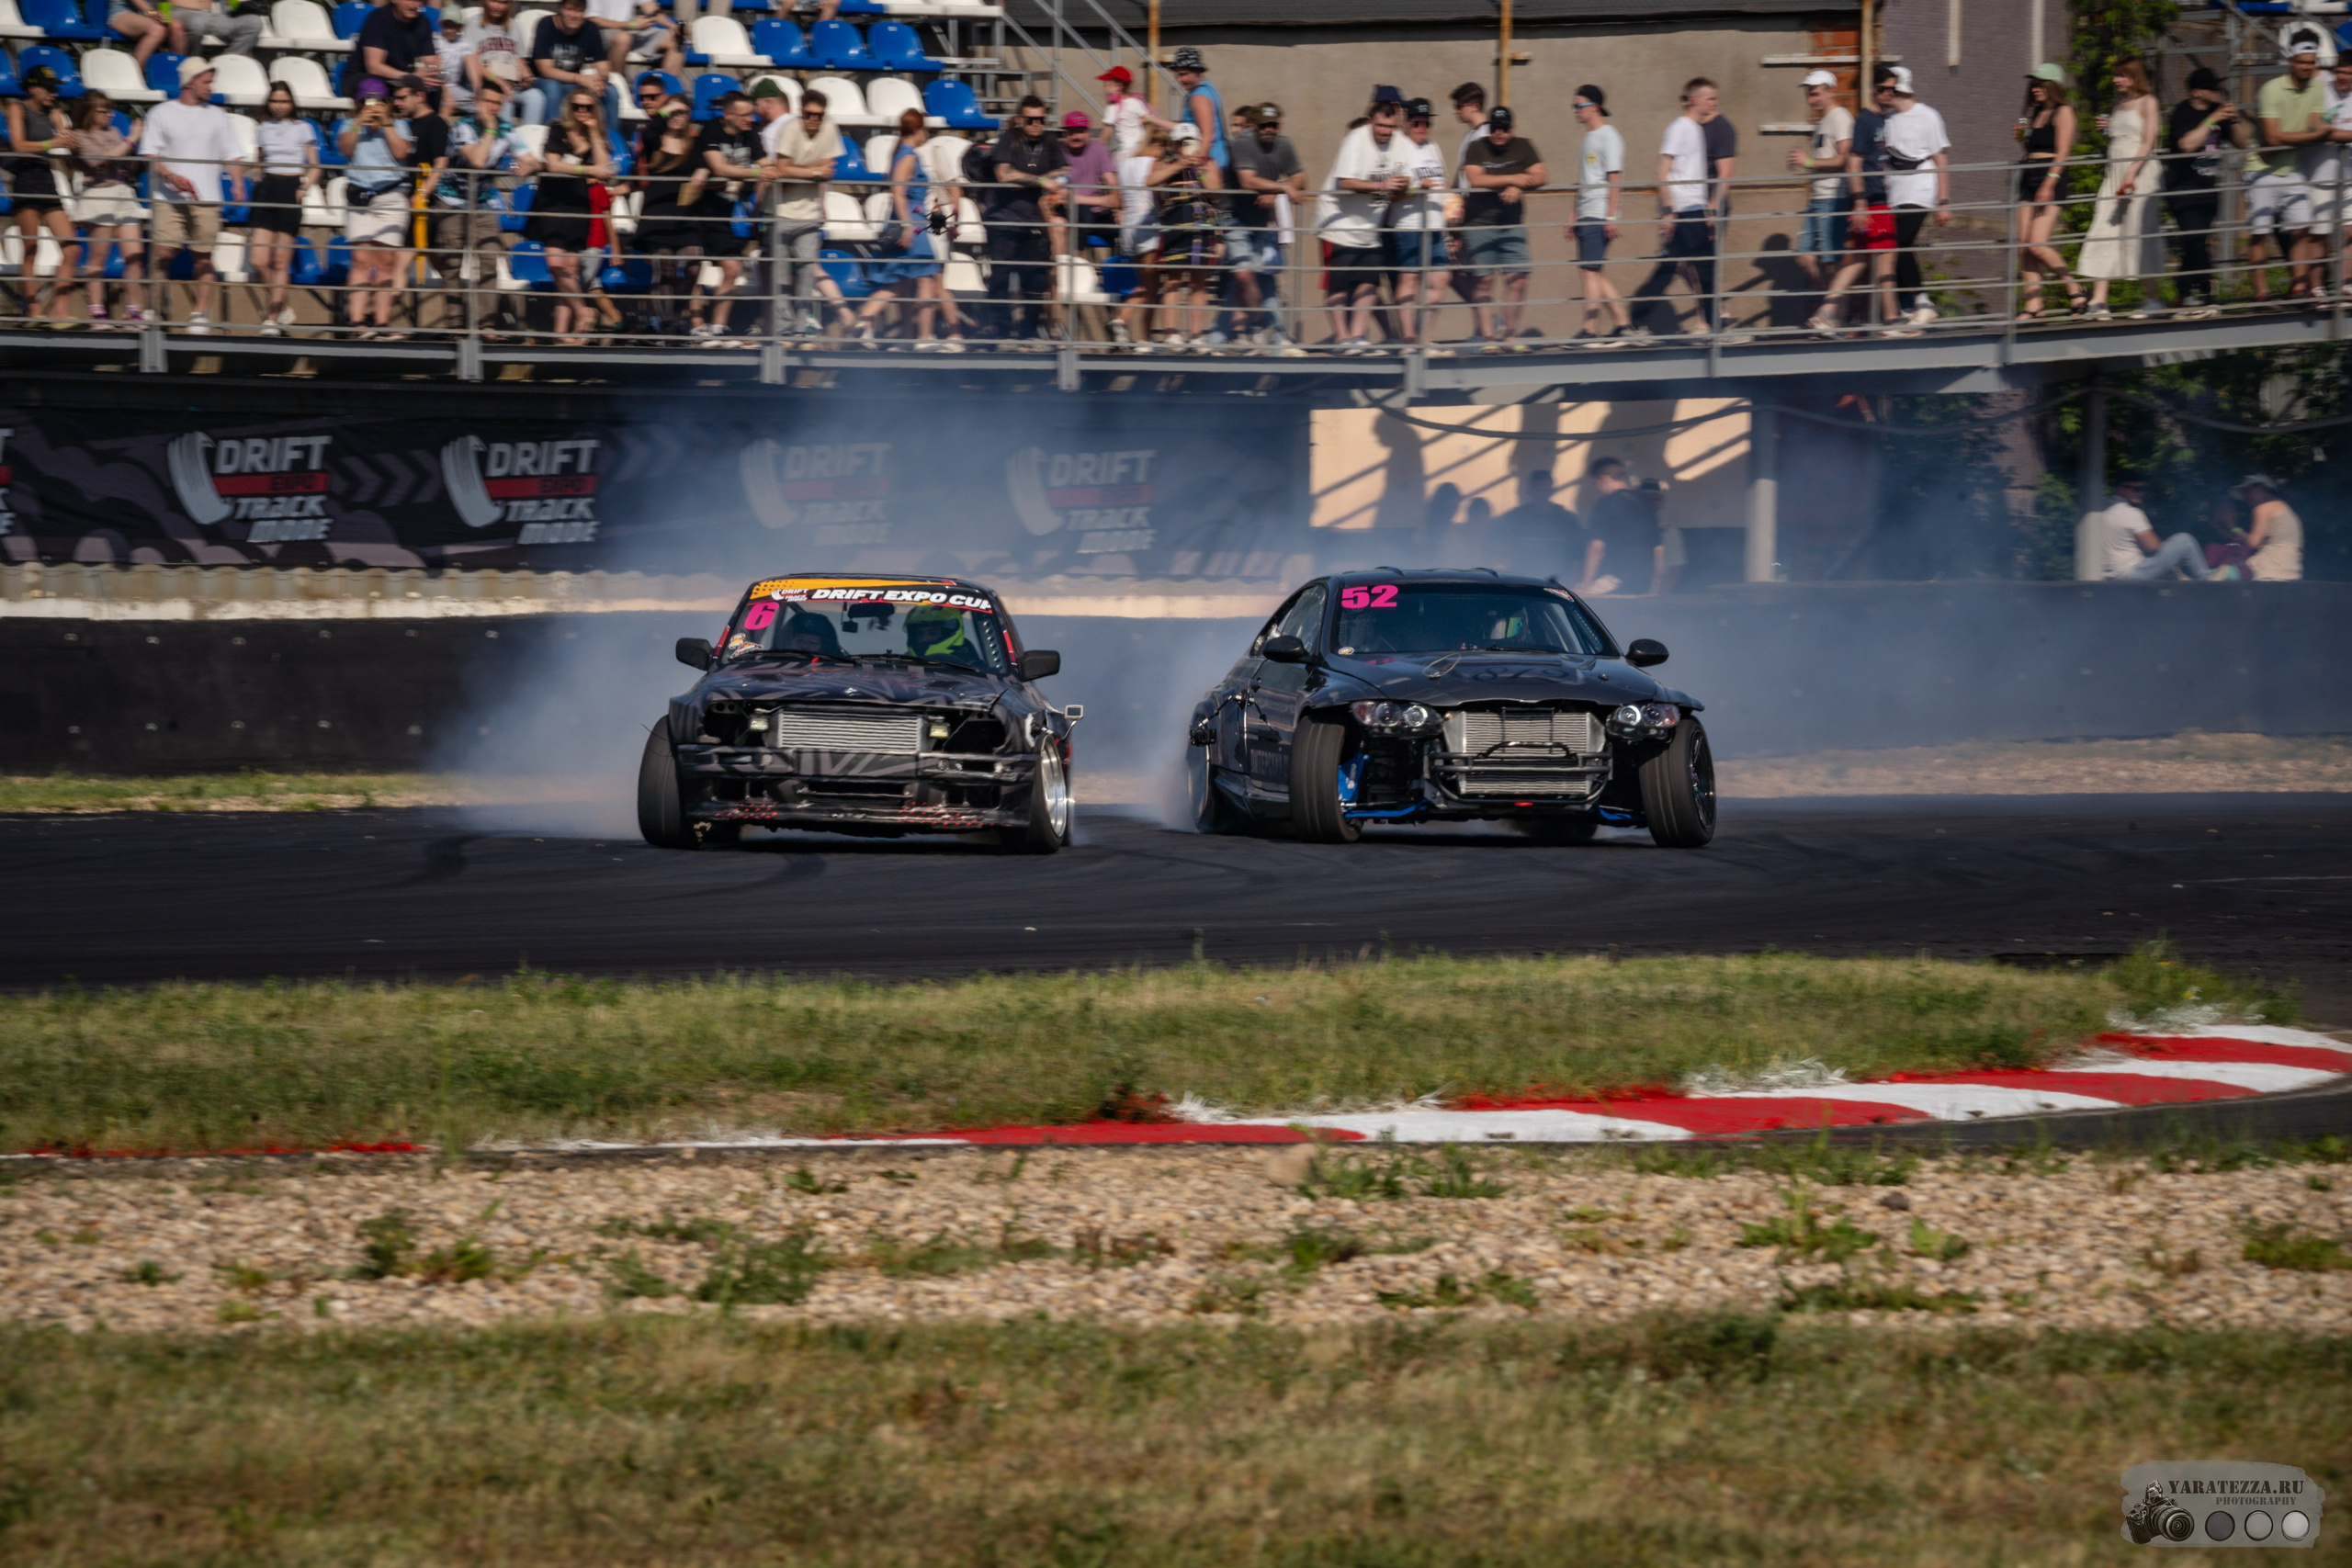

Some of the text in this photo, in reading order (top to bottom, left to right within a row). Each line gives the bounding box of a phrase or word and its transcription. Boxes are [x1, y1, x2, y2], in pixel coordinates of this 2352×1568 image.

[214, 435, 333, 474] DRIFT
[484, 439, 600, 477] DRIFT
[783, 442, 892, 479] DRIFT
[1047, 449, 1158, 487] DRIFT
[811, 589, 885, 601] DRIFT
[883, 590, 946, 604] EXPO
[1340, 584, 1398, 610] 52
[743, 601, 780, 631] 6
